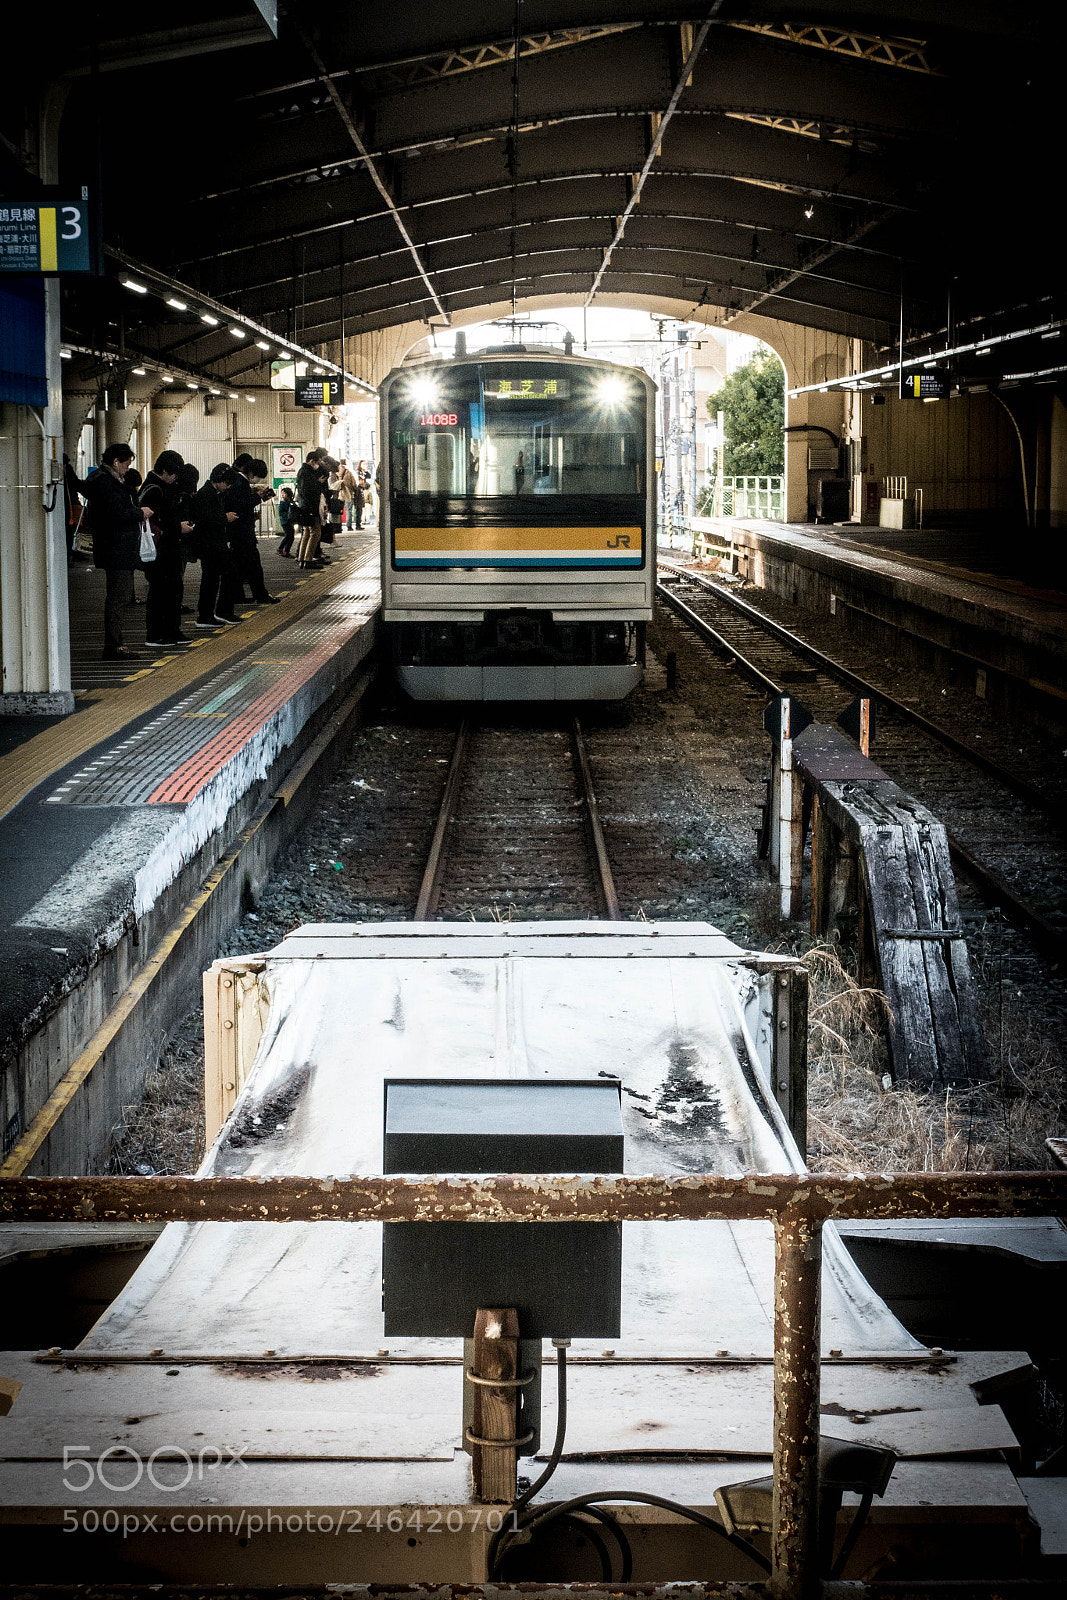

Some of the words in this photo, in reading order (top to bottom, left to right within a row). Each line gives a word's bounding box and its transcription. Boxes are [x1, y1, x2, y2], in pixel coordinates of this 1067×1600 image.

[20, 223, 37, 231] Line
[61, 206, 82, 240] 3
[498, 379, 558, 394] 海芝浦
[905, 375, 914, 387] 4
[330, 382, 338, 394] 3
[420, 413, 458, 426] 1408B
[606, 534, 631, 549] JR
